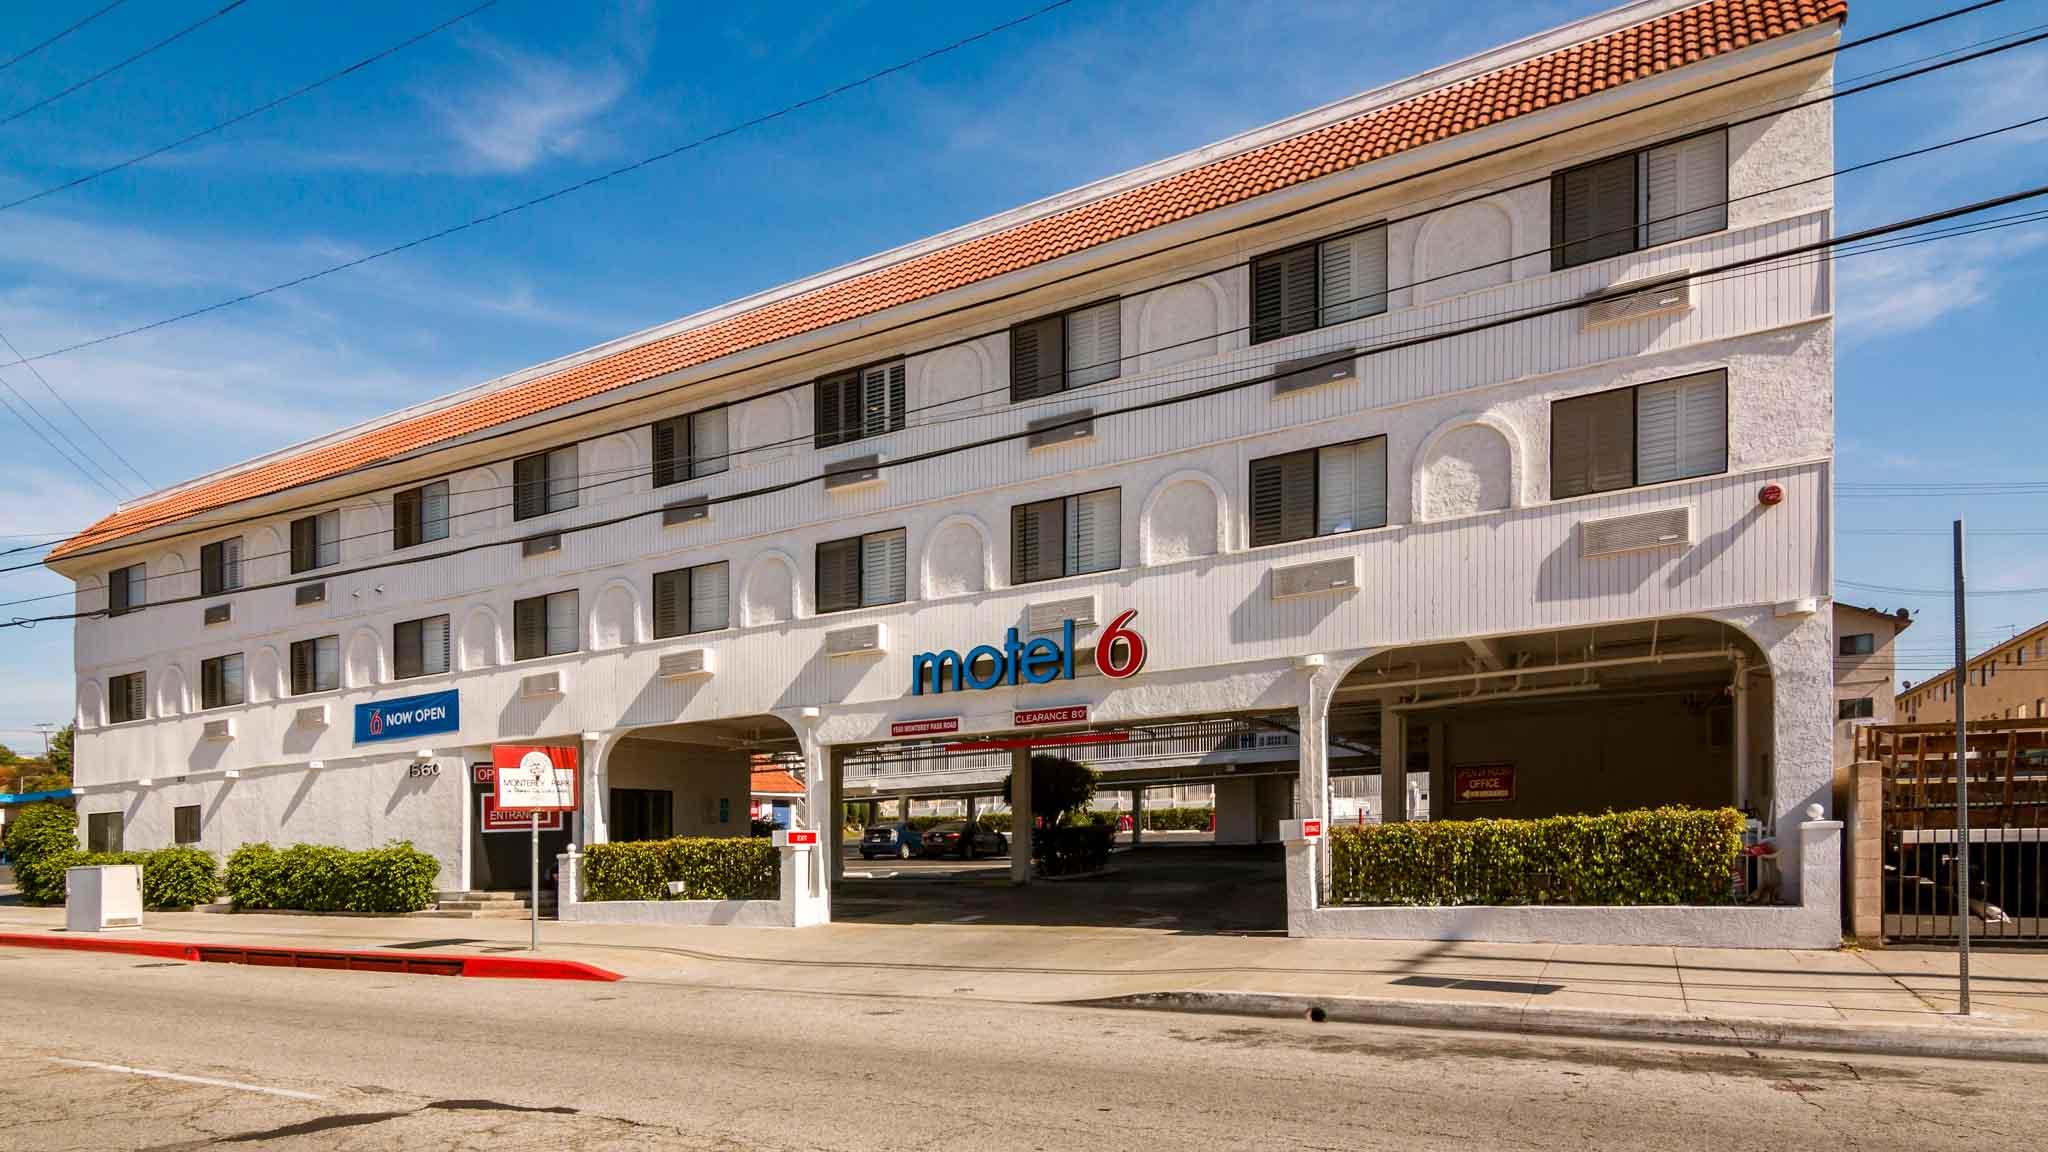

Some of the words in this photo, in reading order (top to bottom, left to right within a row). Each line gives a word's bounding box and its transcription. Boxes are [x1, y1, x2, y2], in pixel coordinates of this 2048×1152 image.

[912, 619, 1075, 696] motel
[1095, 608, 1147, 679] 6
[386, 712, 413, 727] NOW
[415, 706, 446, 722] OPEN
[1015, 711, 1068, 724] CLEARANCE
[904, 724, 929, 732] MONTEREY
[943, 721, 957, 729] ROAD
[409, 763, 441, 778] 1560
[478, 769, 494, 781] OP
[503, 778, 545, 788] MONTEREY
[552, 778, 570, 786] PARK
[1469, 778, 1501, 789] OFFICE
